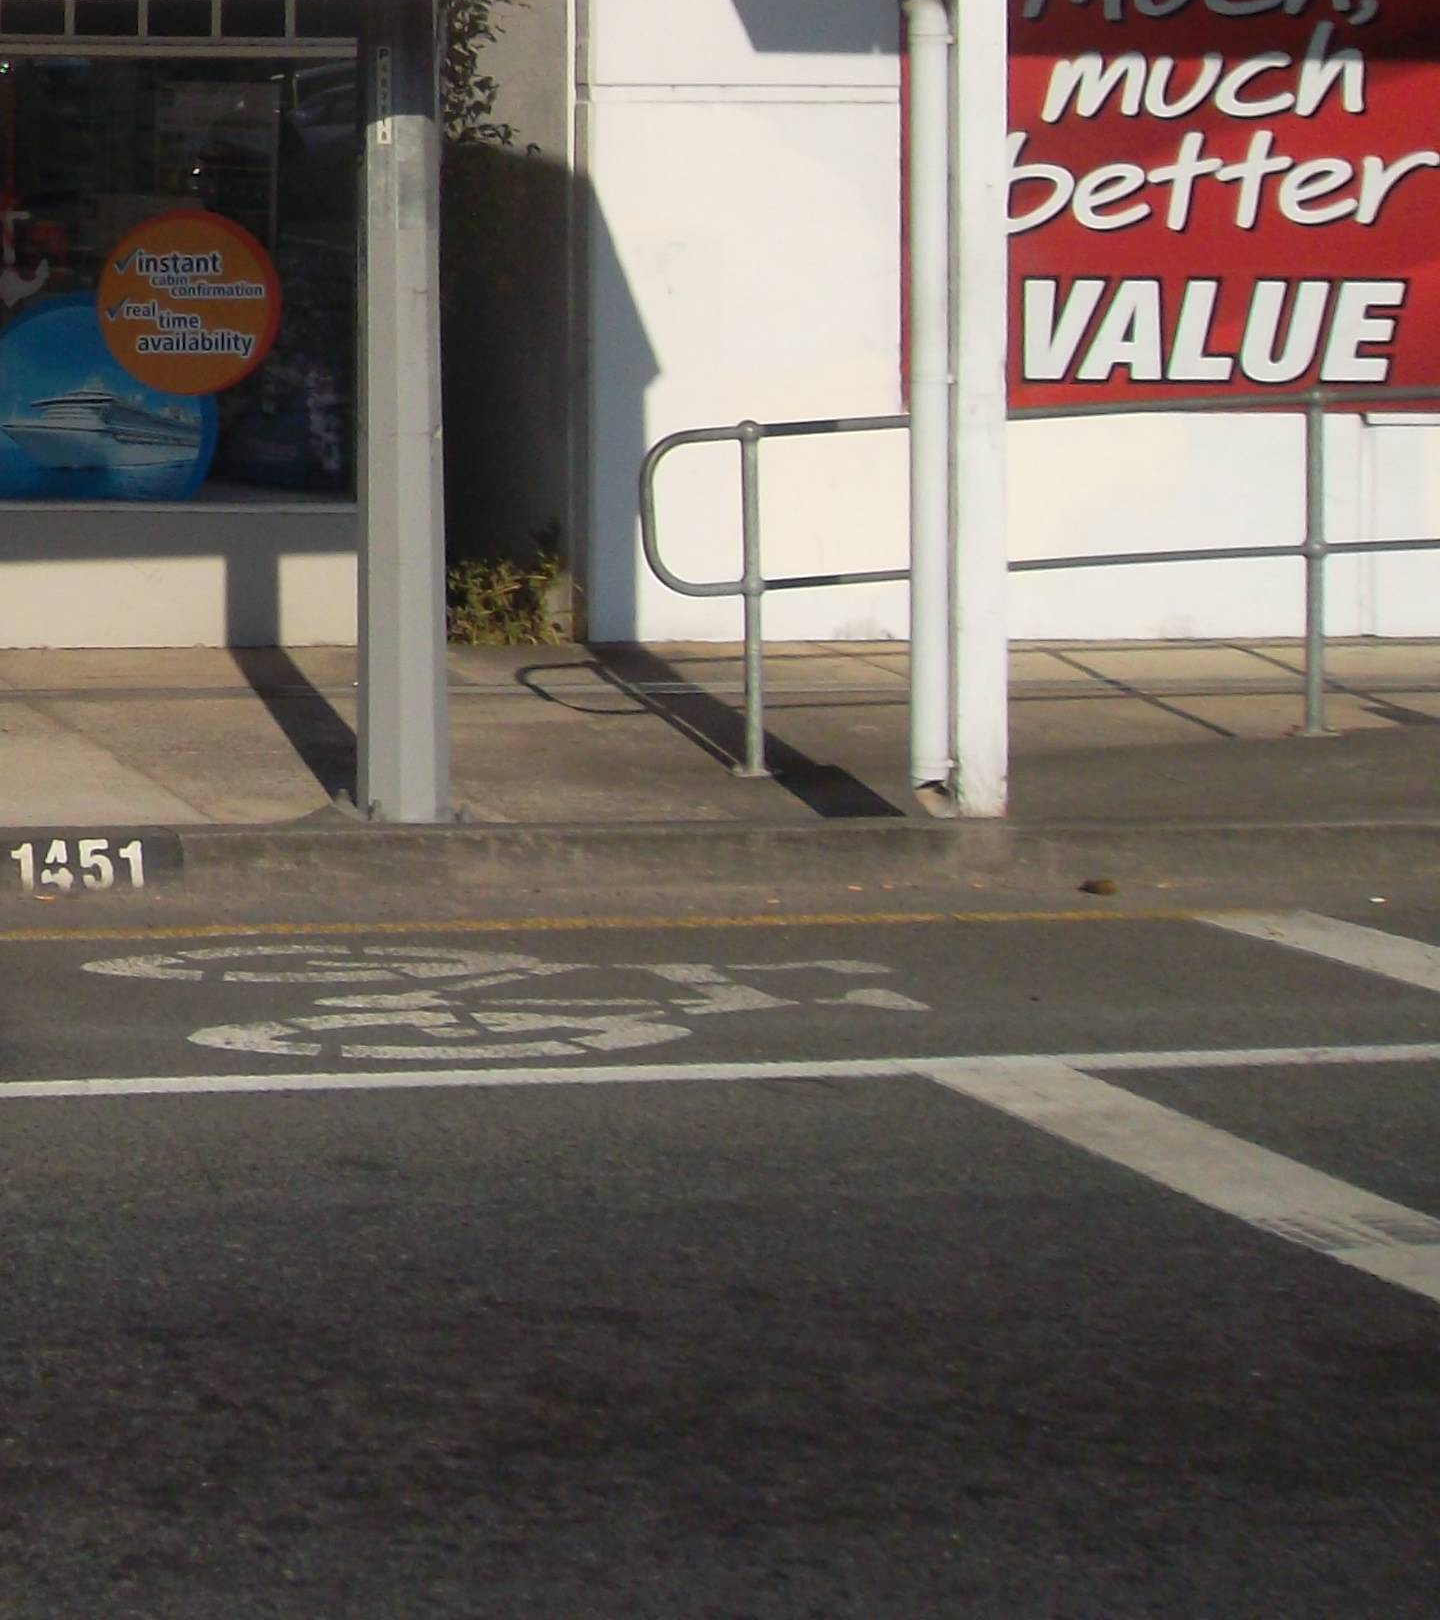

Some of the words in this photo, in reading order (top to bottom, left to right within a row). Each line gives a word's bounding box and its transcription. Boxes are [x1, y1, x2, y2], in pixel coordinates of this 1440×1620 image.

[1041, 21, 1364, 123] much
[1007, 130, 1440, 234] better
[138, 251, 220, 273] instant
[171, 282, 262, 297] confirmation
[126, 302, 156, 317] real
[158, 312, 199, 328] time
[1024, 279, 1406, 382] VALUE
[138, 332, 252, 356] availability
